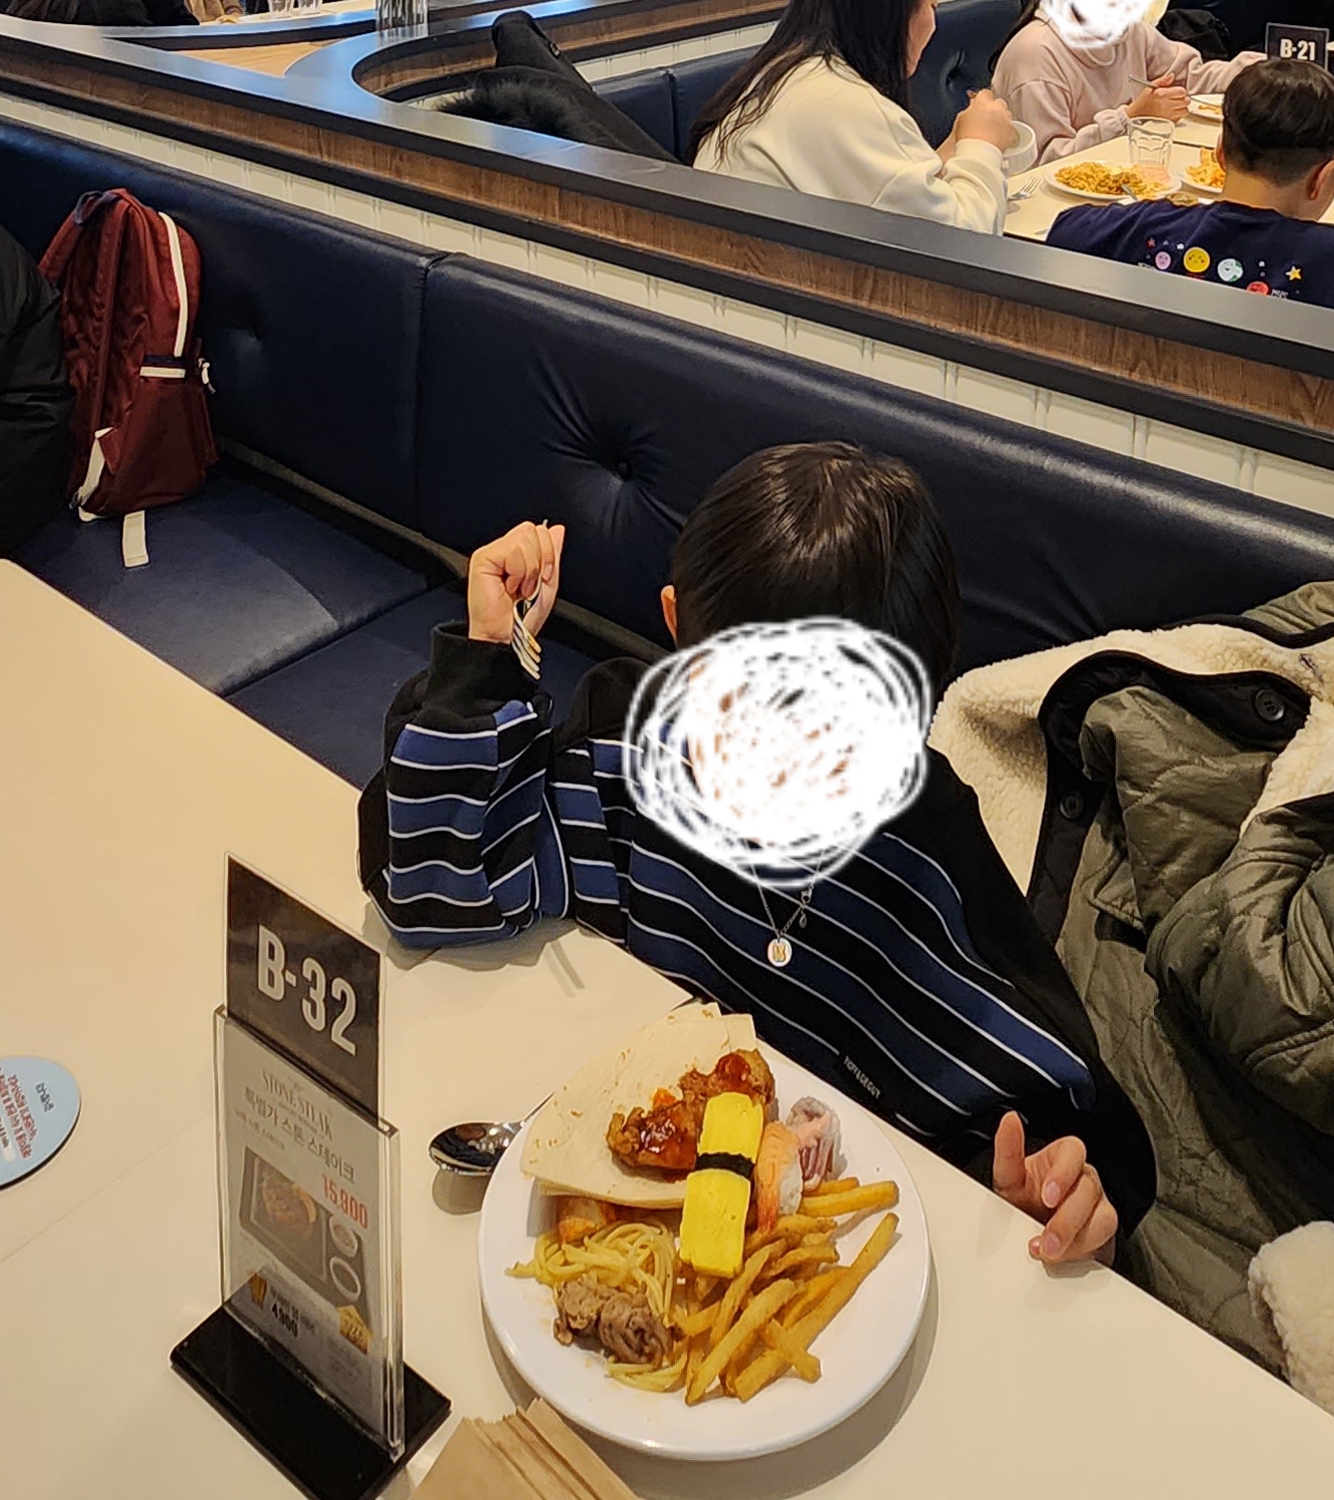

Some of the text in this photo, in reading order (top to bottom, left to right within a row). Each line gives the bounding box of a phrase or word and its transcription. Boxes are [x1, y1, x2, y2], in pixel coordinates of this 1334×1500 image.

[1280, 38, 1316, 61] B-21
[257, 923, 357, 1057] B-32
[308, 1136, 356, 1184] 스테이크
